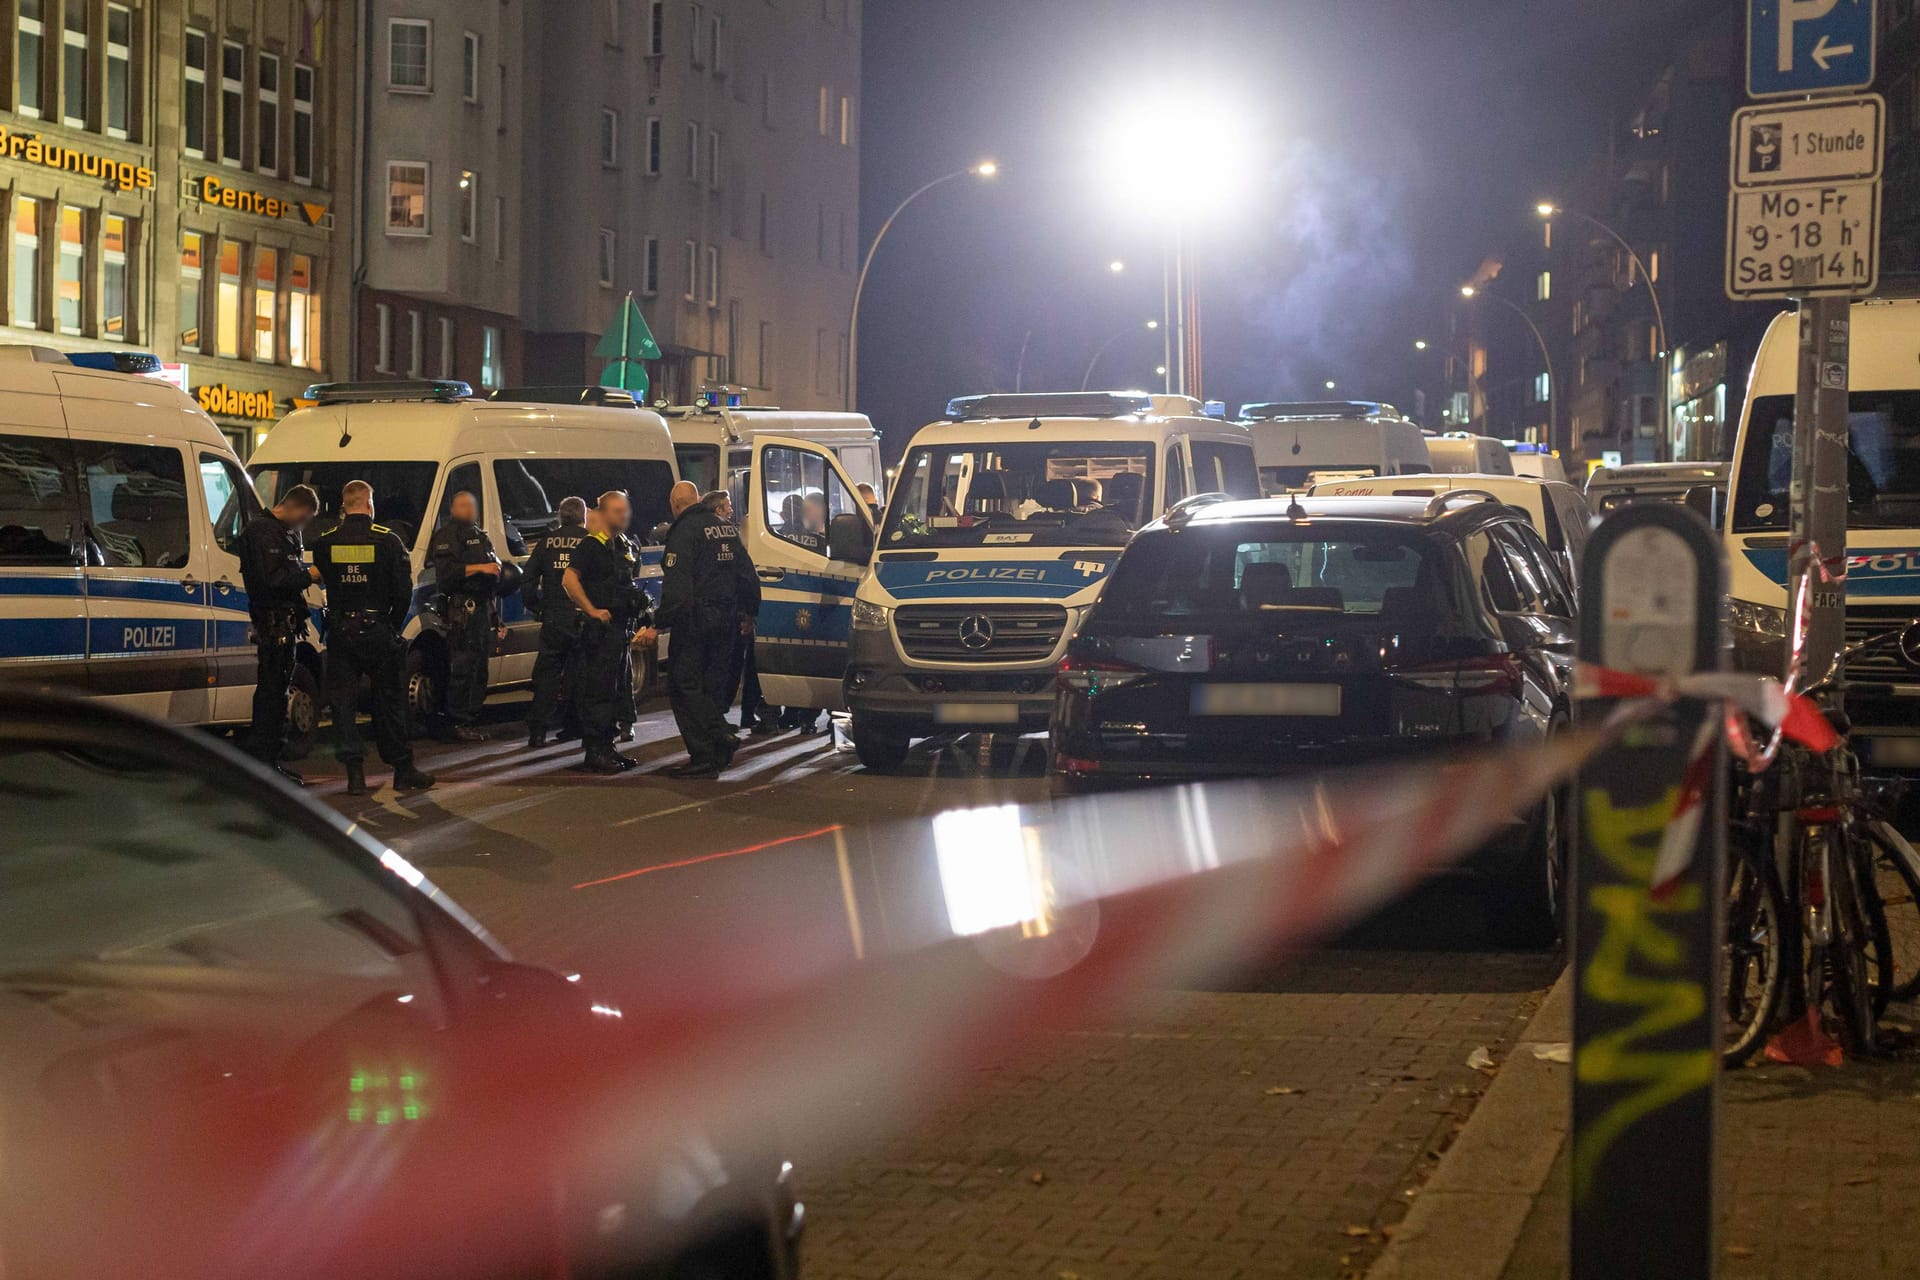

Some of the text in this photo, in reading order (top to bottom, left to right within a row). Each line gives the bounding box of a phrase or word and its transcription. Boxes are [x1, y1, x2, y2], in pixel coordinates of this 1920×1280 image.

[1793, 129, 1865, 155] 1 Stunde
[202, 175, 289, 217] Center
[1739, 257, 1773, 283] Sa
[199, 383, 275, 419] solarent
[703, 525, 737, 540] POLIZEI
[341, 574, 368, 583] 14104
[347, 564, 360, 574] BE
[925, 567, 1047, 582] POLIZEI
[123, 626, 176, 649] POLIZEI
